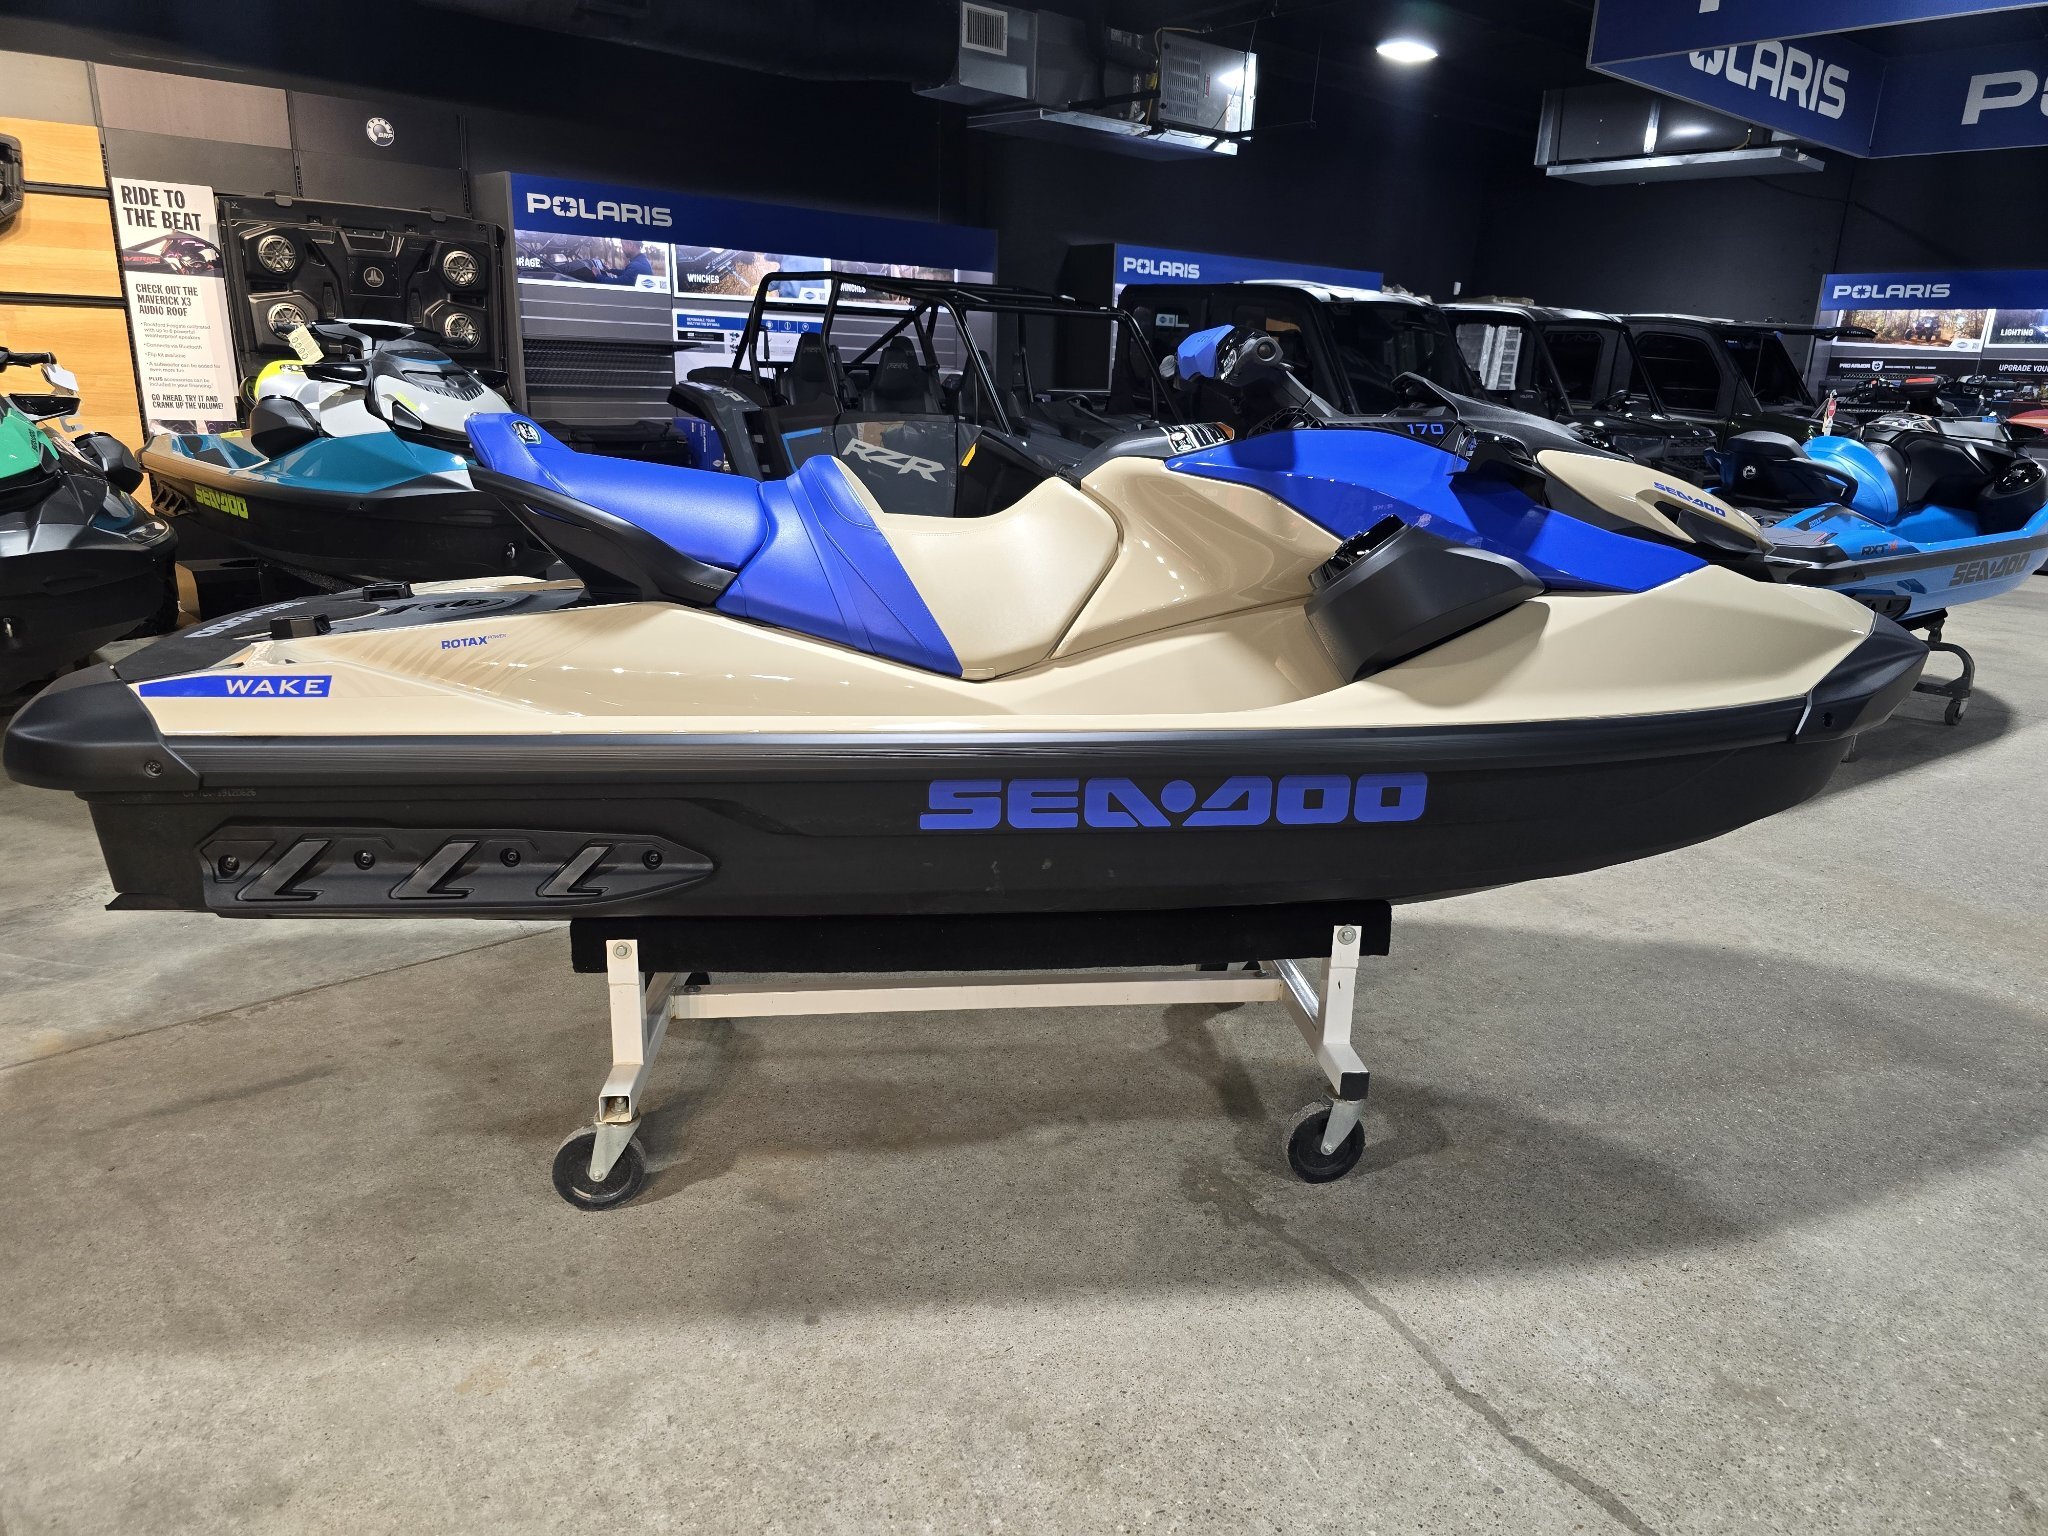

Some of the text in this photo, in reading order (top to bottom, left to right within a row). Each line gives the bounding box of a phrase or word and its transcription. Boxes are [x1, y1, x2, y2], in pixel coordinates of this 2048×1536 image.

[121, 185, 185, 209] RIDE TO
[526, 192, 673, 227] POLARIS
[123, 207, 201, 231] THE BEAT
[1123, 257, 1200, 279] POLARIS
[687, 273, 720, 284] WINCHES
[136, 283, 199, 297] CHECK OUT THE
[1832, 283, 1951, 300] POLARIS
[137, 294, 192, 306] MAVERICK X3
[139, 305, 188, 317] AUDIO ROOF
[2000, 328, 2034, 336] LIGHTING
[1999, 364, 2032, 372] UPGRADE
[152, 401, 175, 409] CRANK
[1407, 423, 1444, 435] 170
[842, 437, 945, 483] RZR
[441, 636, 488, 650] ROTAX
[225, 679, 325, 695] WAKE
